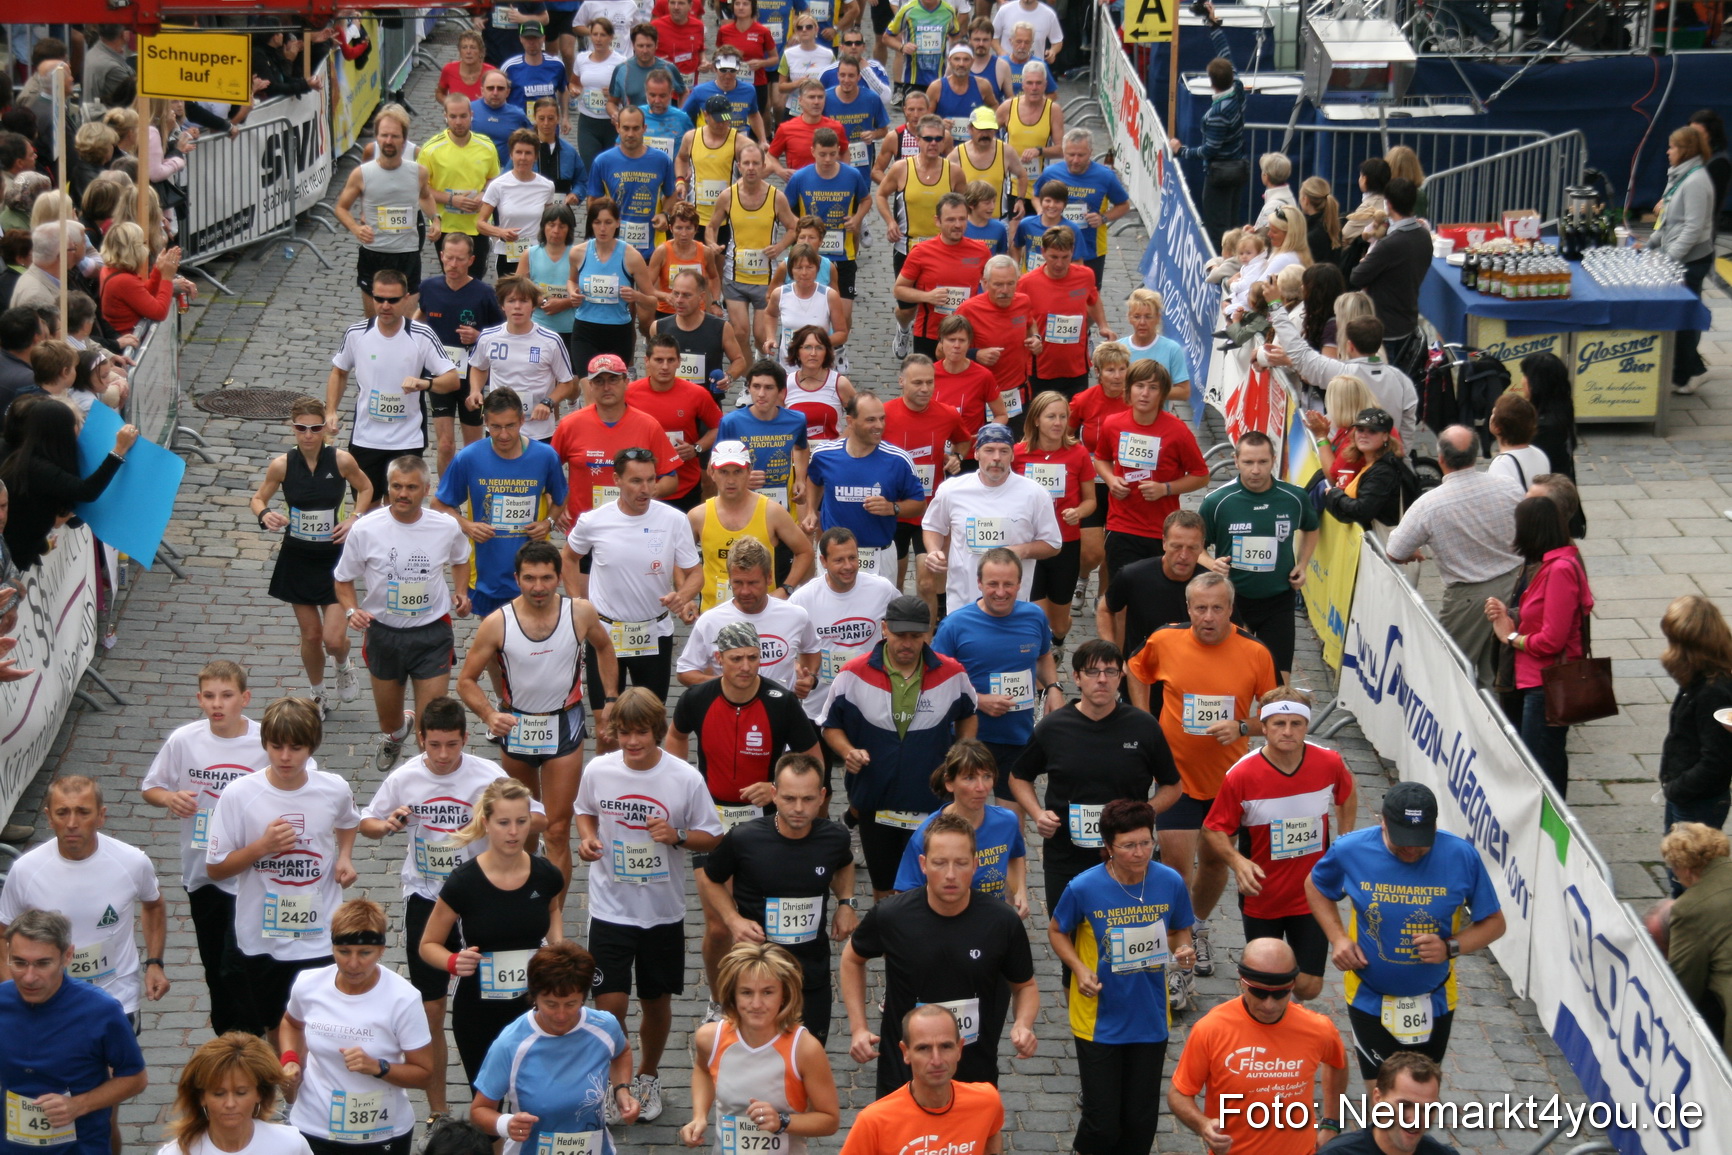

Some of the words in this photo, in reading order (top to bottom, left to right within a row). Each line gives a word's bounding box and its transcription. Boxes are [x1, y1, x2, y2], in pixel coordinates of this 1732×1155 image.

[1136, 0, 1167, 24] A
[923, 40, 939, 48] 3175
[147, 45, 242, 67] Schnupper-
[179, 67, 210, 83] lauf
[524, 83, 554, 92] HUBER
[620, 172, 658, 180] NEUMARKTER
[390, 216, 408, 225] 958
[626, 232, 646, 240] 2222
[747, 259, 763, 267] 417
[592, 285, 615, 295] 3372
[1056, 325, 1078, 334] 2345
[489, 342, 509, 361] 20
[1577, 335, 1659, 374] Glossner
[680, 365, 699, 374] 390
[1617, 356, 1655, 374] Bier
[380, 394, 401, 402] Stephan
[379, 404, 405, 413] 2092
[750, 434, 794, 442] NEUMARKTER
[1130, 436, 1147, 446] Florian
[749, 441, 786, 449] STADTLAUF
[1128, 446, 1154, 459] 2555
[488, 479, 538, 487] NEUMARKTER
[1035, 476, 1060, 487] 2551
[835, 486, 882, 497] HUBER
[301, 513, 319, 521] Beate
[505, 508, 531, 519] 2824
[302, 522, 331, 532] 2123
[977, 519, 993, 527] Frank
[1228, 522, 1252, 531] JURA
[978, 530, 1006, 541] 3021
[1244, 550, 1272, 560] 3760
[386, 573, 396, 581] 9.
[401, 594, 430, 605] 3805
[624, 625, 642, 633] Frank
[816, 622, 867, 635] GERHART
[629, 633, 651, 646] 302
[832, 654, 847, 662] Jens
[1003, 675, 1020, 684] Franz
[1004, 684, 1031, 698] 3521
[1197, 698, 1222, 707] Thomas
[1197, 709, 1229, 722] 2914
[523, 718, 549, 728] Manfred
[522, 729, 553, 742] 3705
[600, 799, 656, 814] GERHART
[723, 809, 756, 819] Benjamin
[1285, 820, 1308, 830] Martin
[1286, 829, 1318, 845] 2434
[626, 846, 648, 855] Simon
[253, 859, 313, 870] GERHART
[430, 855, 463, 868] 3445
[628, 855, 662, 869] 3423
[1360, 881, 1374, 891] 10.
[1374, 883, 1448, 897] NEUMARKTER
[280, 899, 297, 908] Alex
[1371, 892, 1433, 906] STADTLAUF
[782, 901, 814, 911] Christian
[1093, 910, 1107, 919] 10.
[1107, 903, 1169, 917] NEUMARKTER
[281, 910, 318, 924] 2420
[783, 913, 816, 928] 3137
[1106, 913, 1160, 927] STADTLAUF
[1128, 938, 1161, 955] 6021
[71, 956, 109, 974] 2611
[1403, 1012, 1428, 1028] 864
[311, 1021, 375, 1037] BRIGITTEKARL
[1239, 1057, 1304, 1071] Fischer
[1246, 1070, 1300, 1079] AUTOMOBILE
[349, 1108, 389, 1125] 3874
[29, 1117, 51, 1131] 45
[556, 1136, 585, 1148] Hedwig
[741, 1136, 781, 1150] 3720
